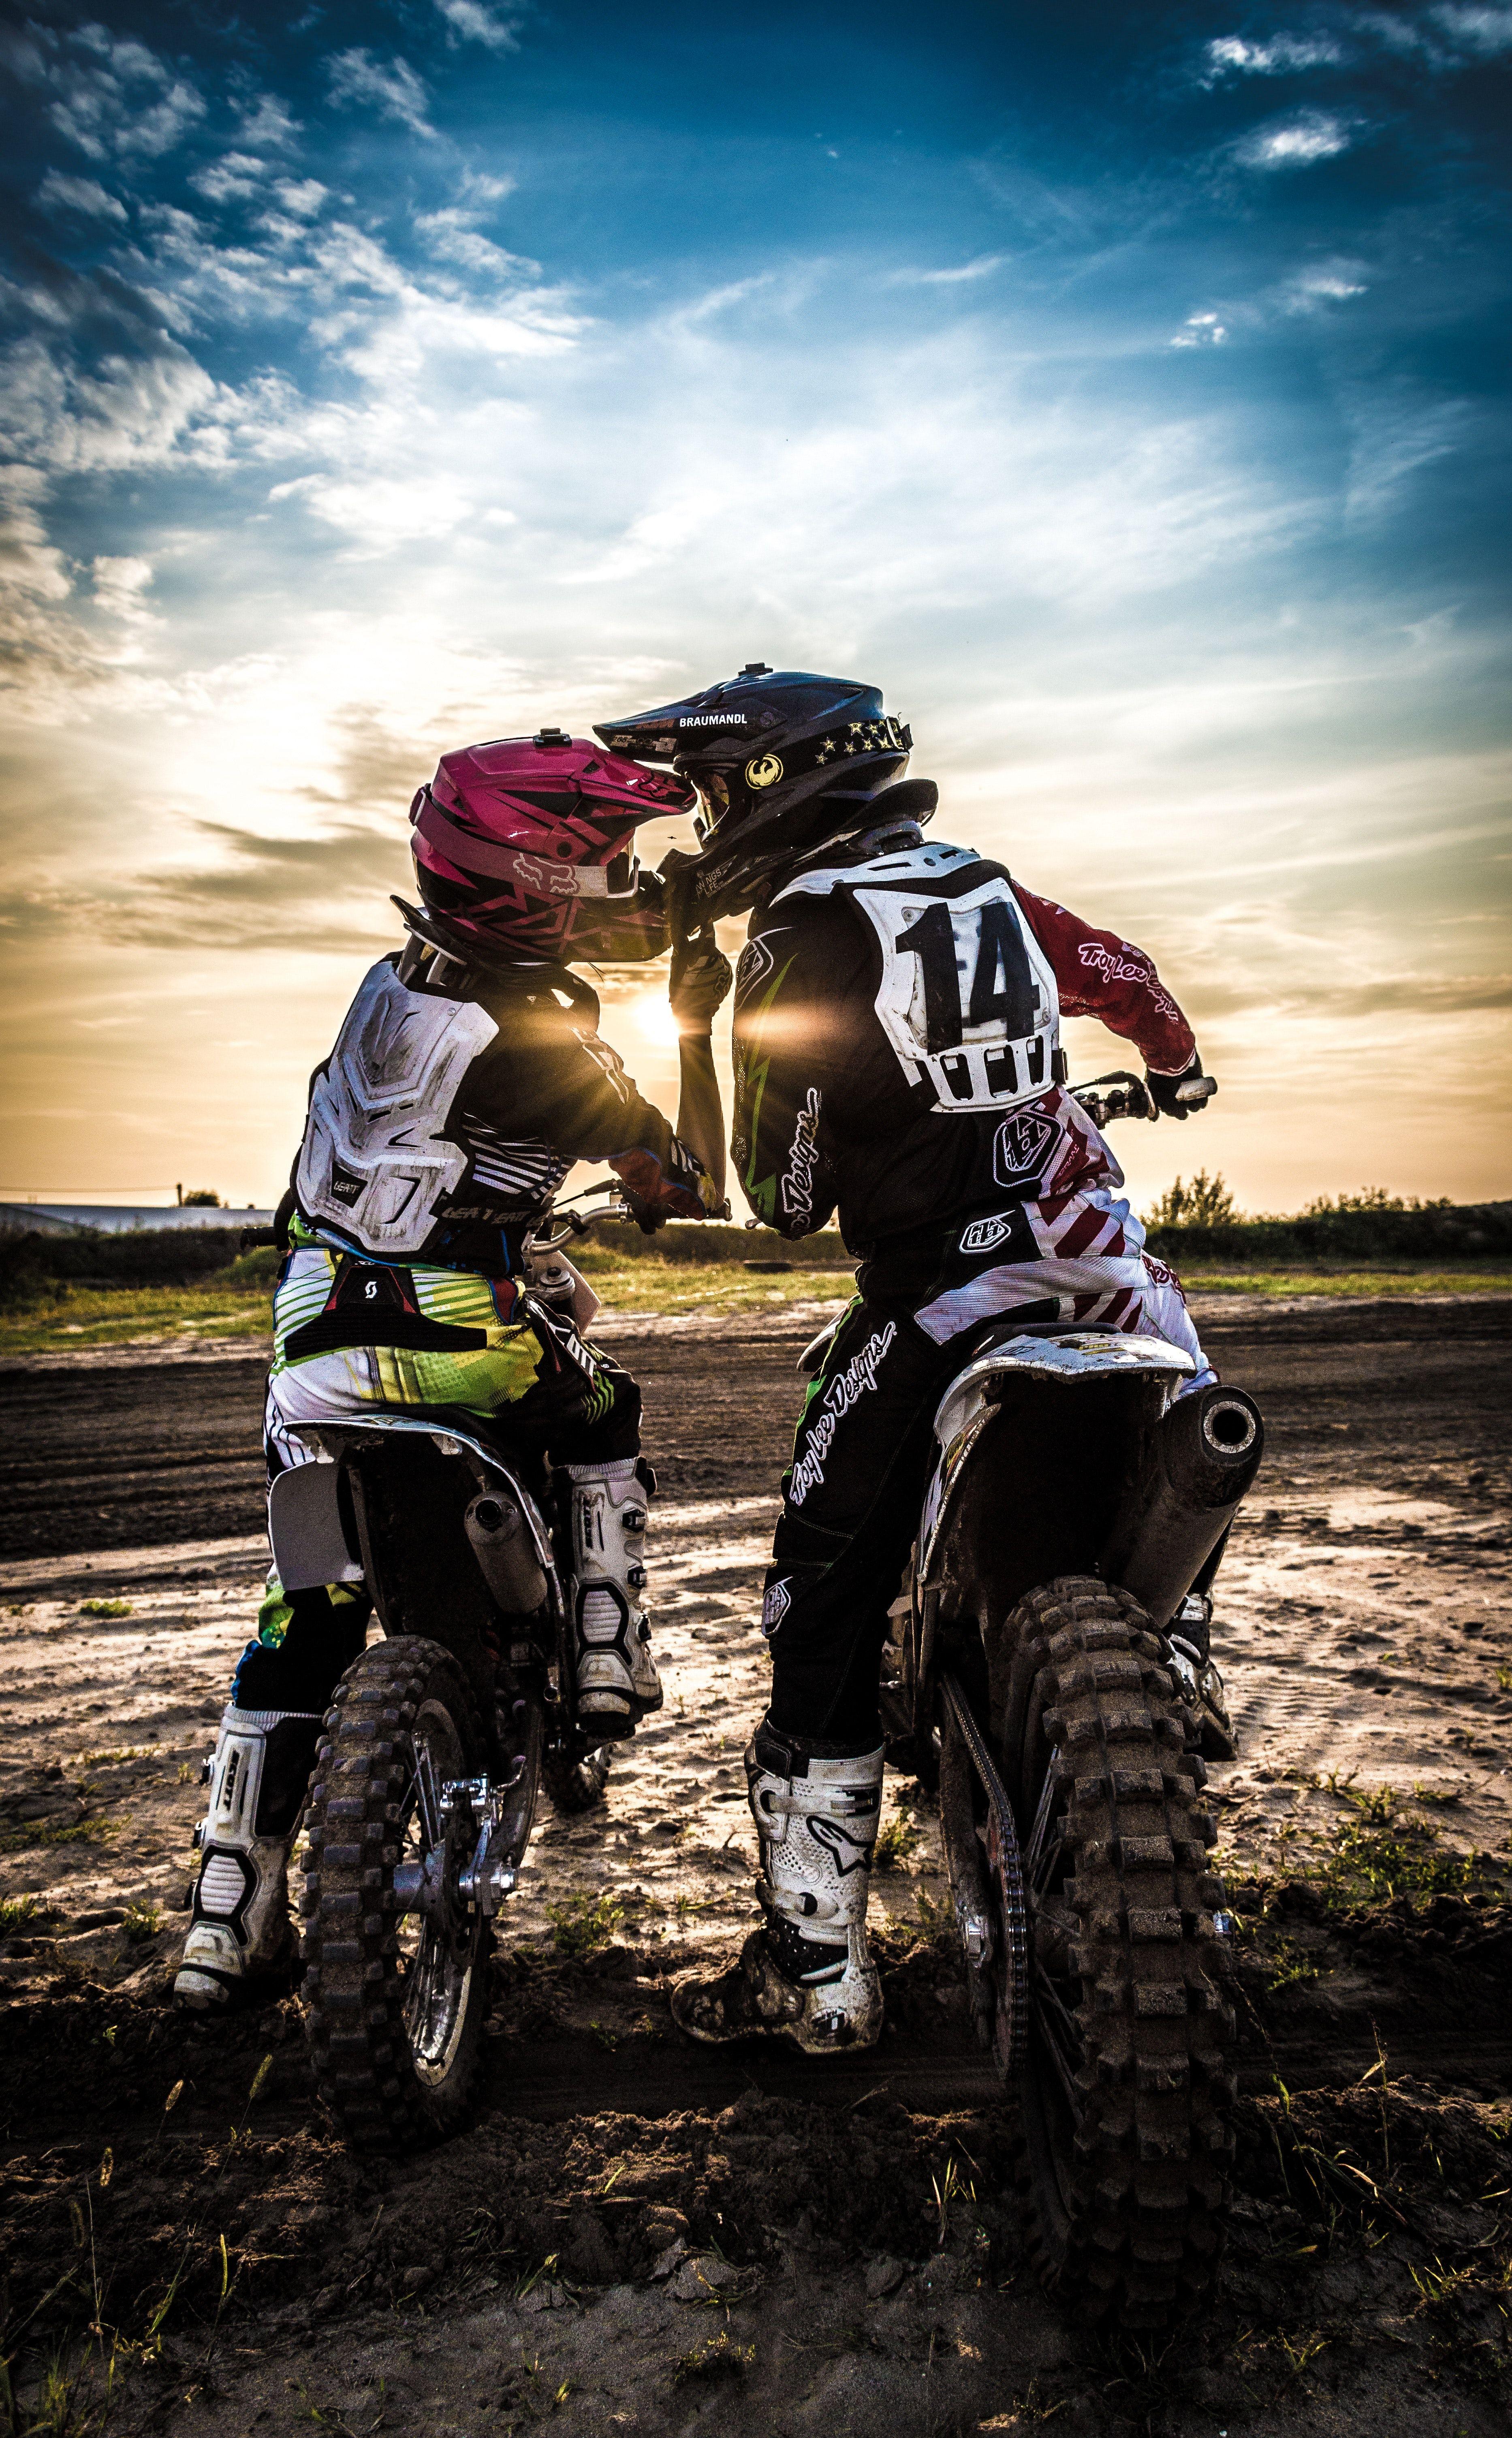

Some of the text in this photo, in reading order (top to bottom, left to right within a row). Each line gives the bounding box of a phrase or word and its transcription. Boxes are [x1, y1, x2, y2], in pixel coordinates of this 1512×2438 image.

[679, 714, 747, 727] BRAUMANDL
[696, 868, 722, 892] WNGS
[895, 902, 1040, 1055] 14
[224, 1749, 239, 1811] SCOTT
